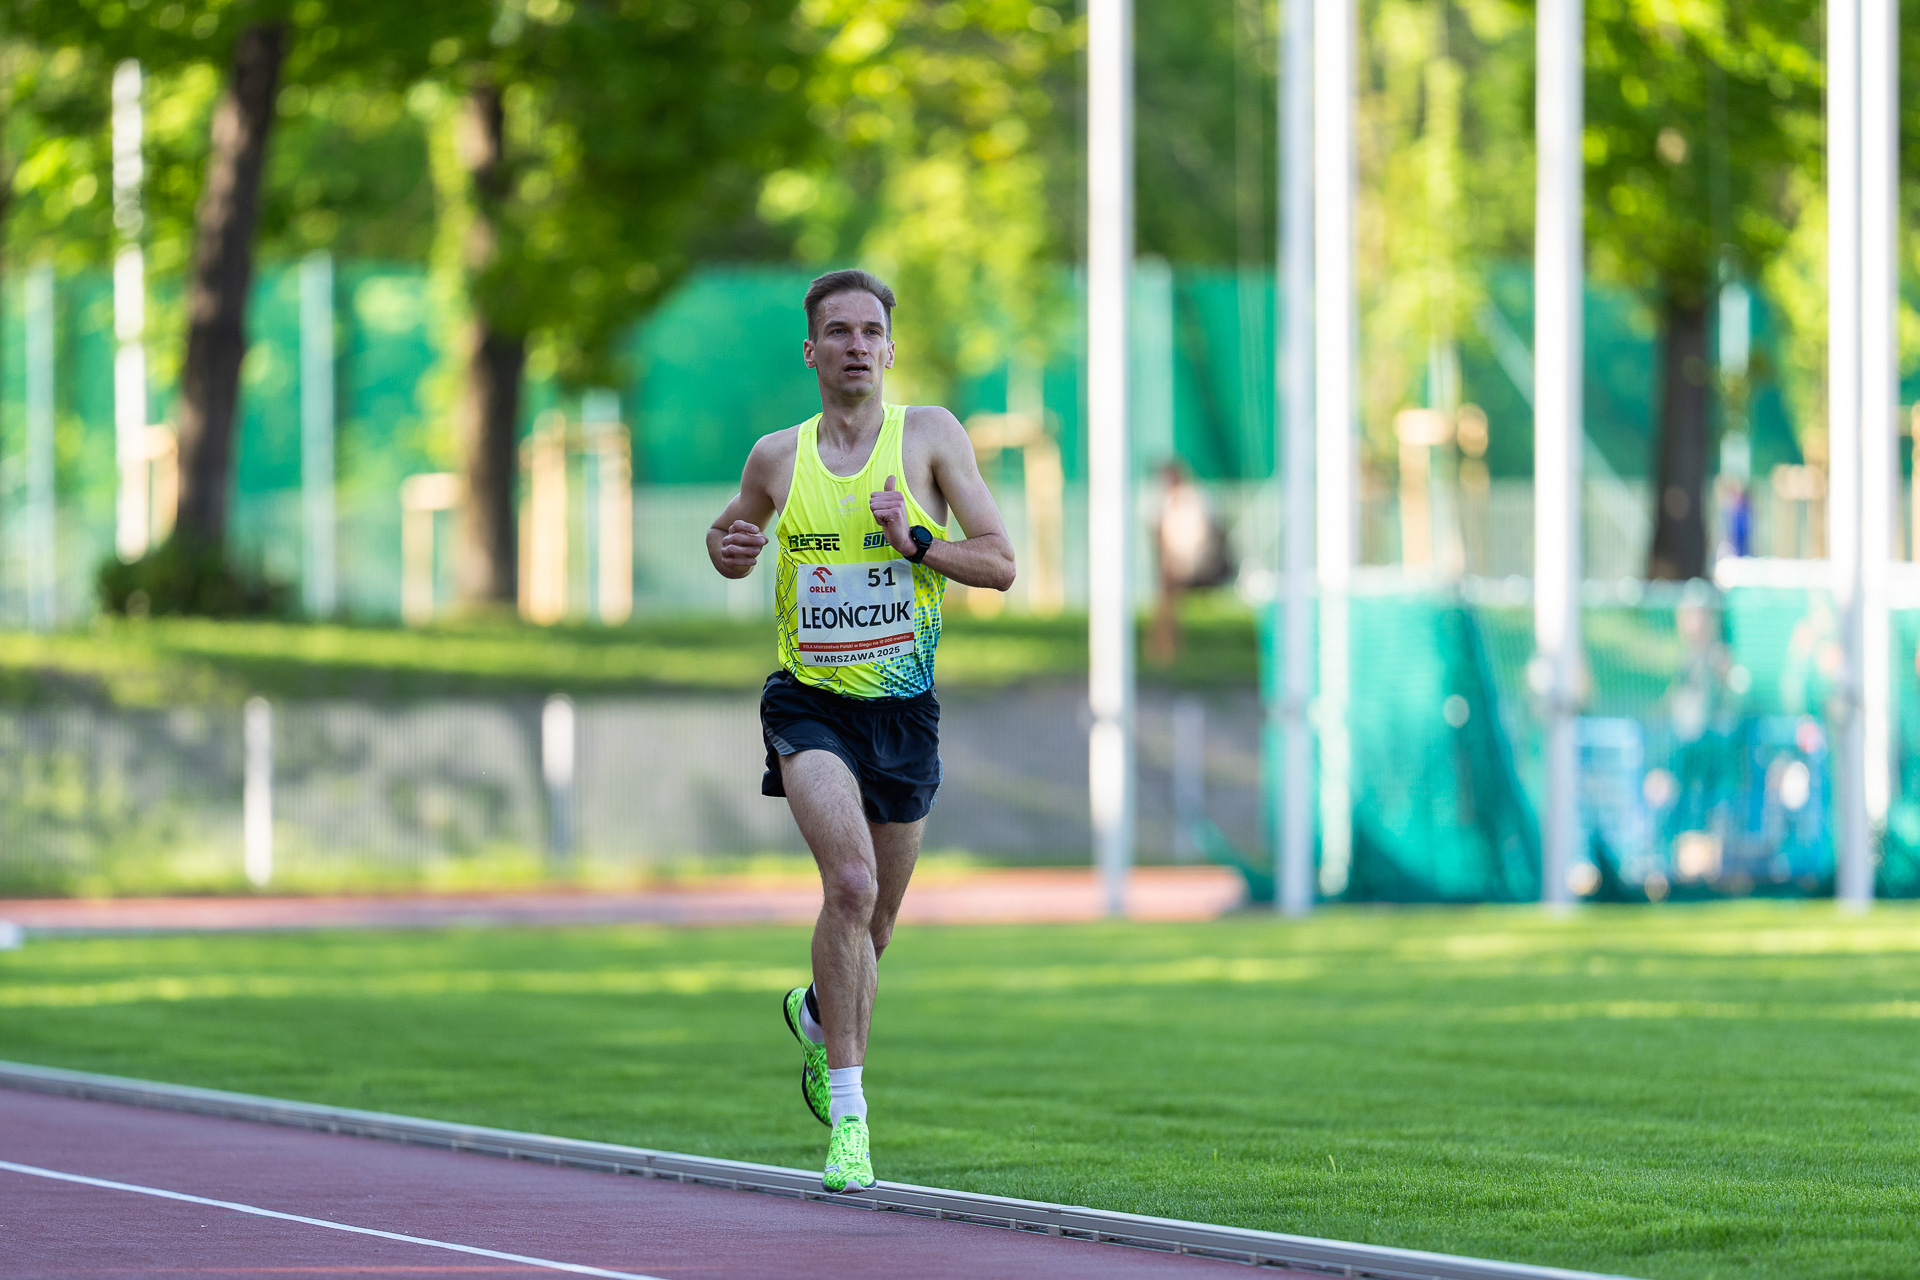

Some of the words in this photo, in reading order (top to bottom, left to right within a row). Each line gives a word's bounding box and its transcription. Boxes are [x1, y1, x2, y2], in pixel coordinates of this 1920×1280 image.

[867, 566, 896, 588] 51
[802, 601, 911, 629] LEOŃCZUK
[814, 652, 875, 663] WARSZAWA
[877, 646, 900, 657] 2025
